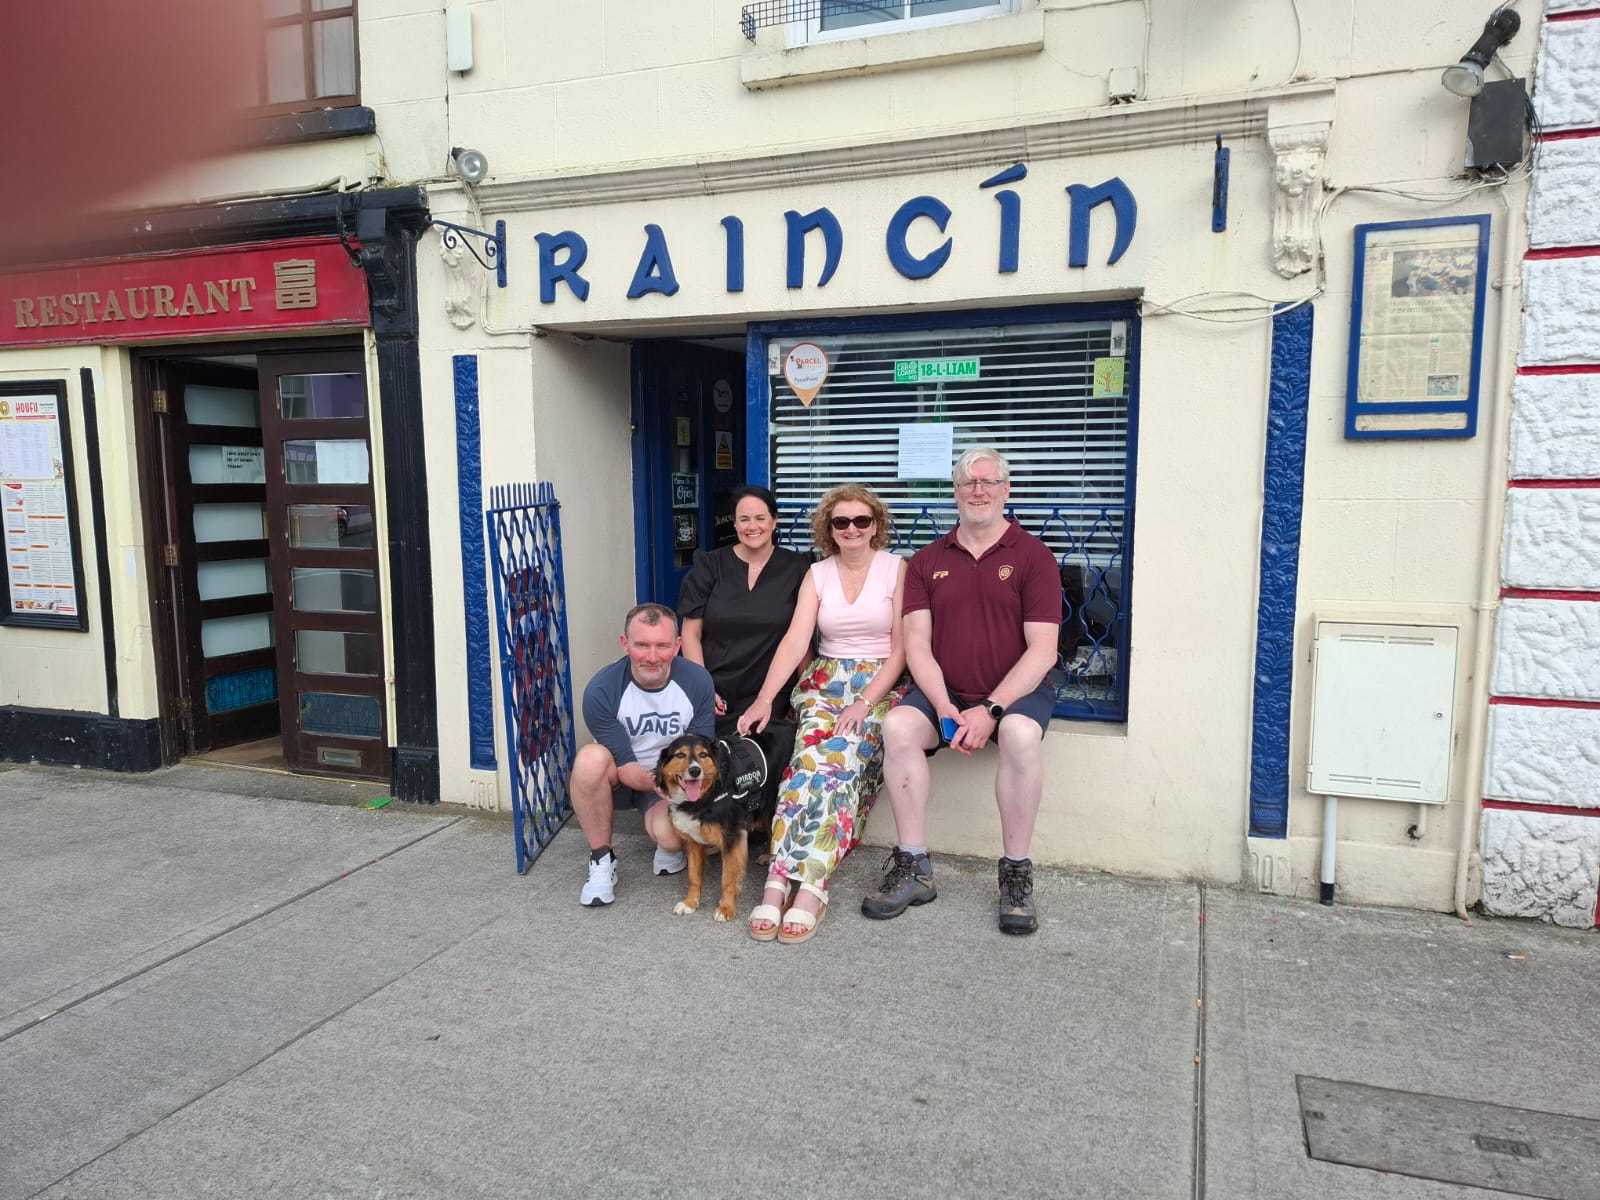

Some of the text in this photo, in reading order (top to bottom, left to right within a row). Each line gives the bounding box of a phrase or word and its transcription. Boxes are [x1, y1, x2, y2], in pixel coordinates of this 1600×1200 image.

[14, 277, 257, 329] RESTAURANT
[795, 357, 821, 365] PARCEL
[15, 401, 39, 414] HOUFU
[625, 712, 681, 737] VANS
